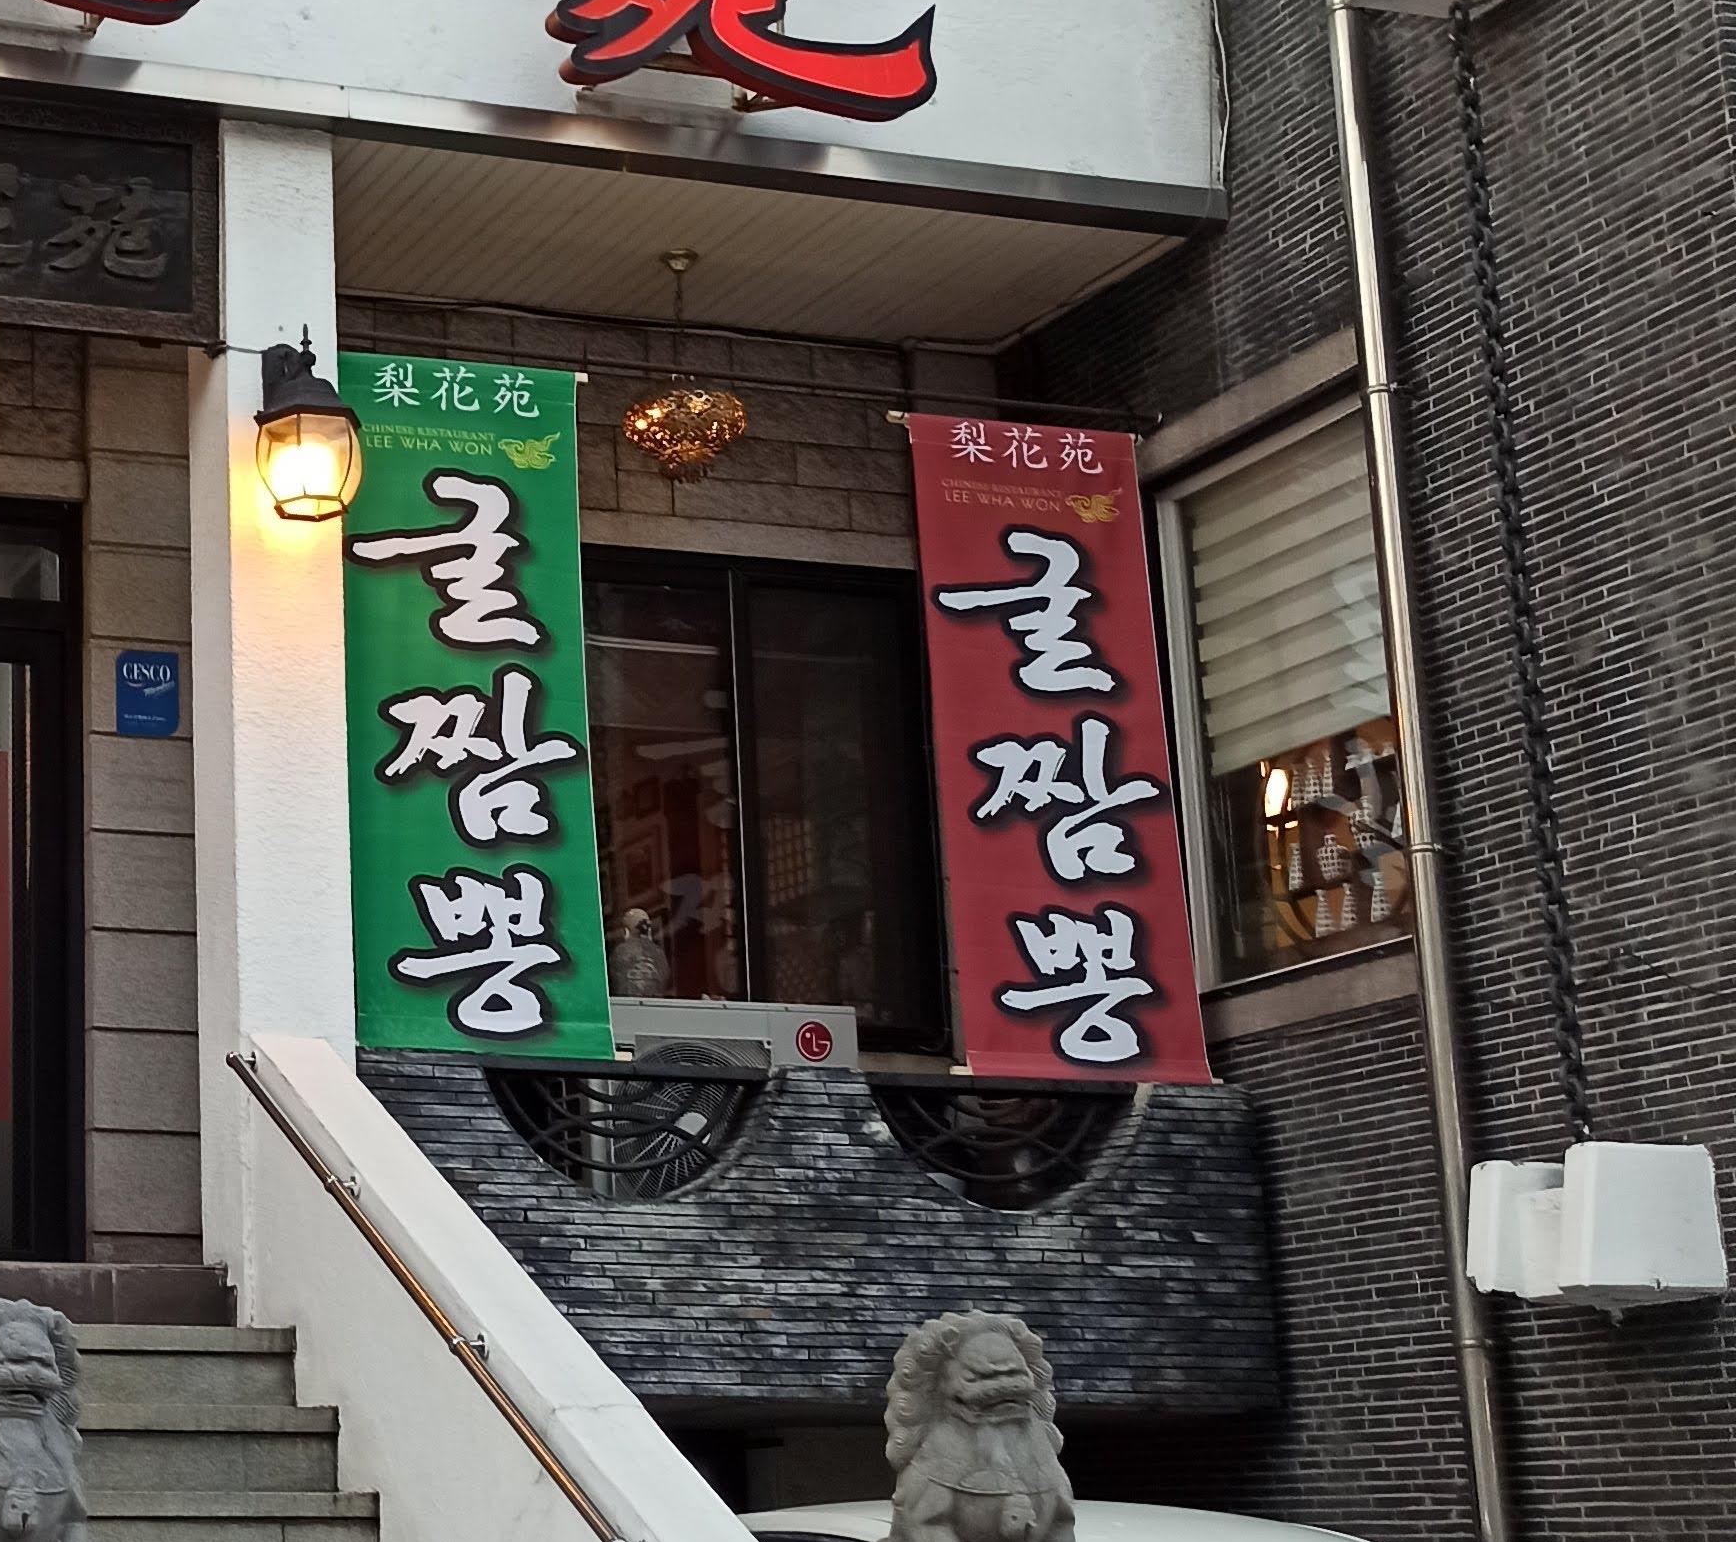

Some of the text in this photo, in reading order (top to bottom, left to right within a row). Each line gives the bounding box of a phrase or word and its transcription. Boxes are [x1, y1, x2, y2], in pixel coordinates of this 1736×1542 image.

[372, 362, 541, 418] 梨花苑
[361, 422, 496, 441] CHINESE RESTAURANT
[365, 434, 493, 456] LEE WHA WON
[950, 421, 1104, 474] 梨花苑
[944, 488, 1061, 512] LEE WHA WON
[122, 662, 171, 682] CESCO
[348, 472, 581, 1035] 굴짬뽕
[936, 528, 1163, 1064] 굴짬뽕
